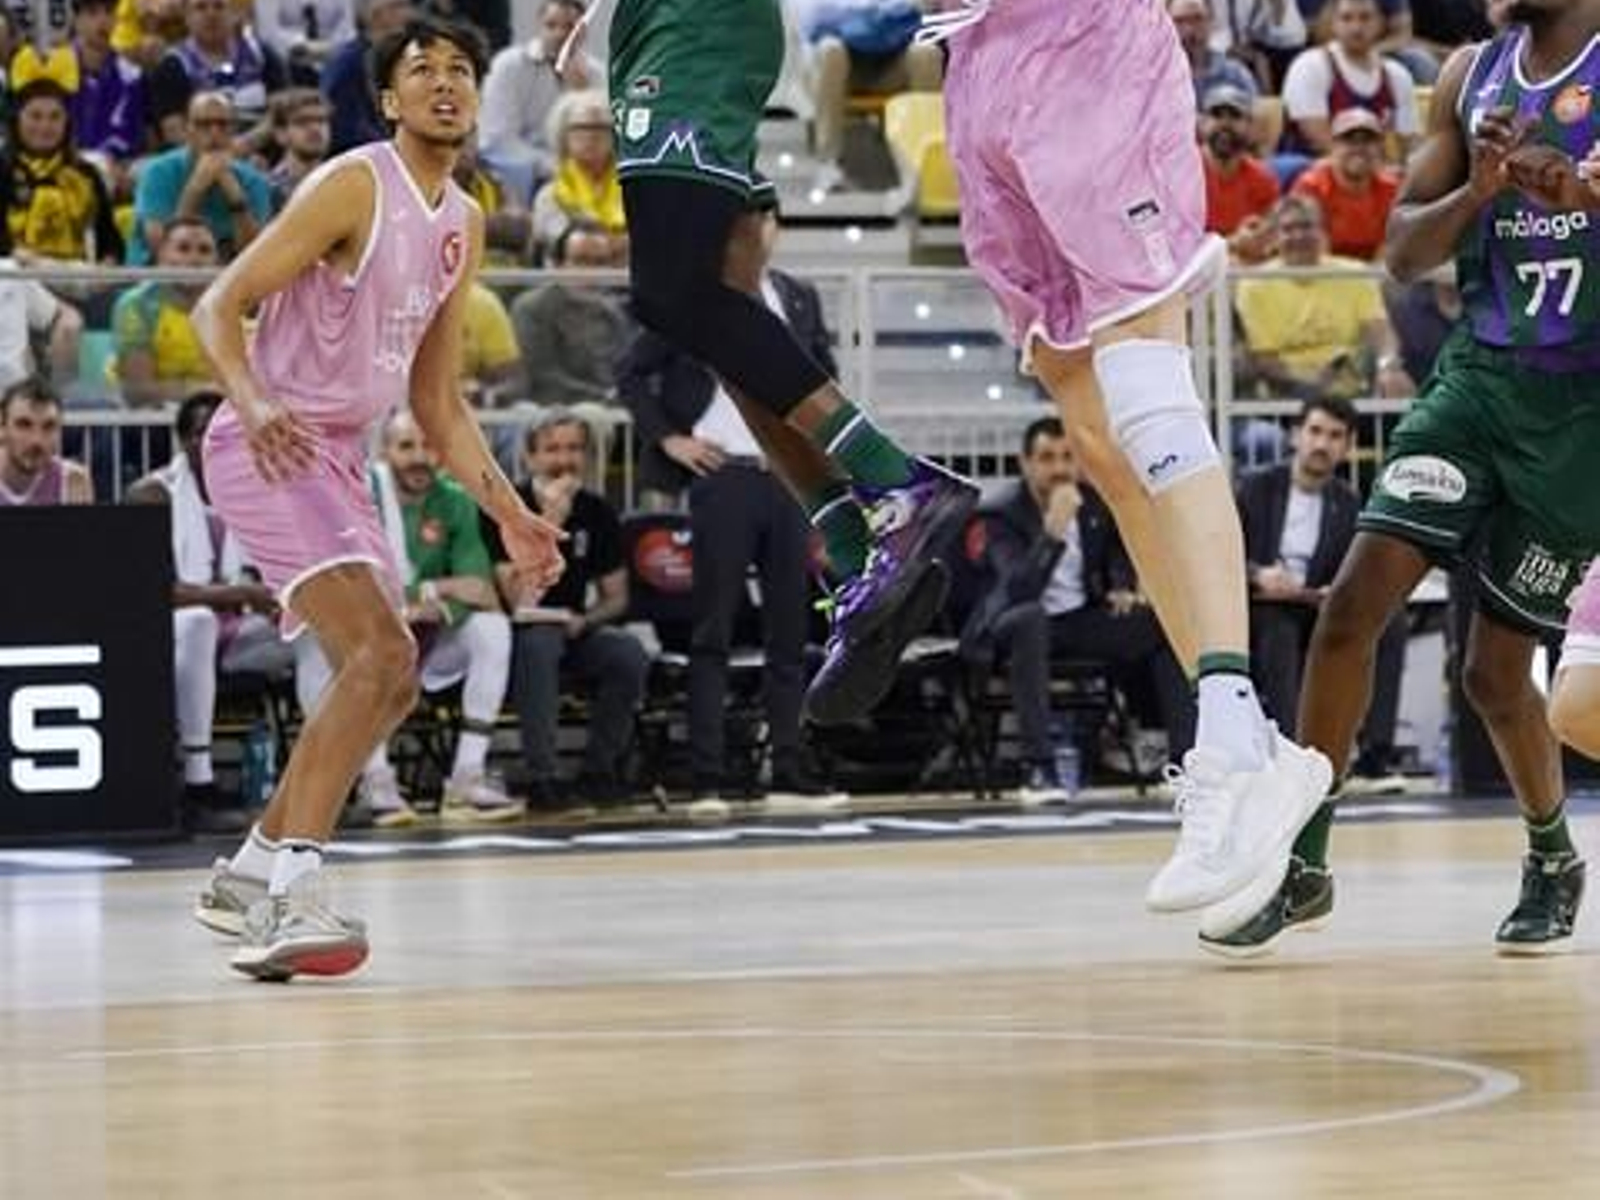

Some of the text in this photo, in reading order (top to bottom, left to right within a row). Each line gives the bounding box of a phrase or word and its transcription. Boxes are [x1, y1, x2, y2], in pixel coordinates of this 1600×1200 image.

[1495, 210, 1589, 240] málaga
[1516, 257, 1584, 316] 77
[10, 684, 103, 793] S
